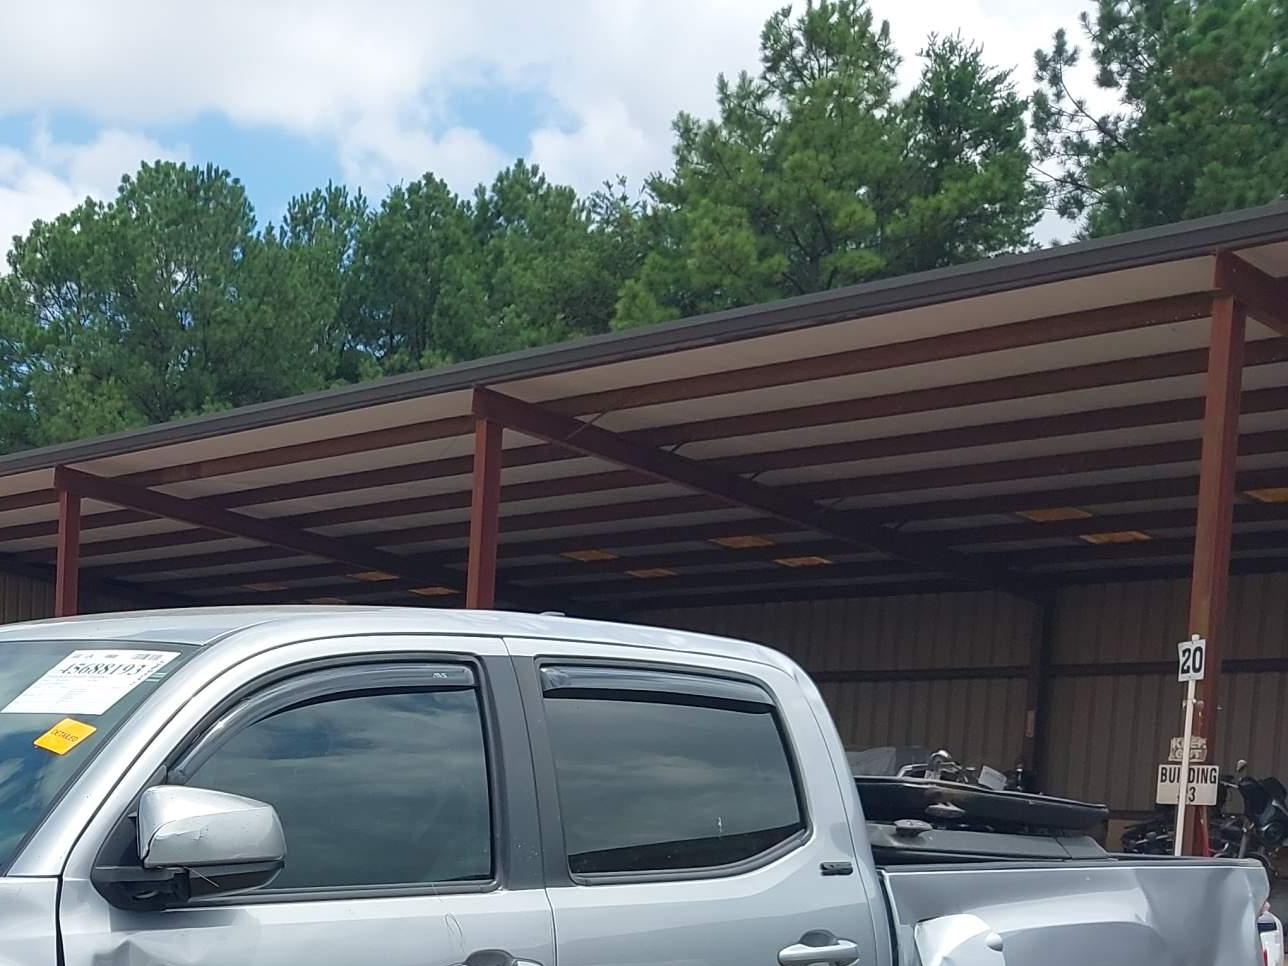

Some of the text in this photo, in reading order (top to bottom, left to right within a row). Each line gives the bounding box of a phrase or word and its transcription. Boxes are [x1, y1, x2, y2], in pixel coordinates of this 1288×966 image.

[1181, 646, 1204, 674] 20
[1160, 766, 1217, 784] BUIDING
[1177, 786, 1196, 802] 3
